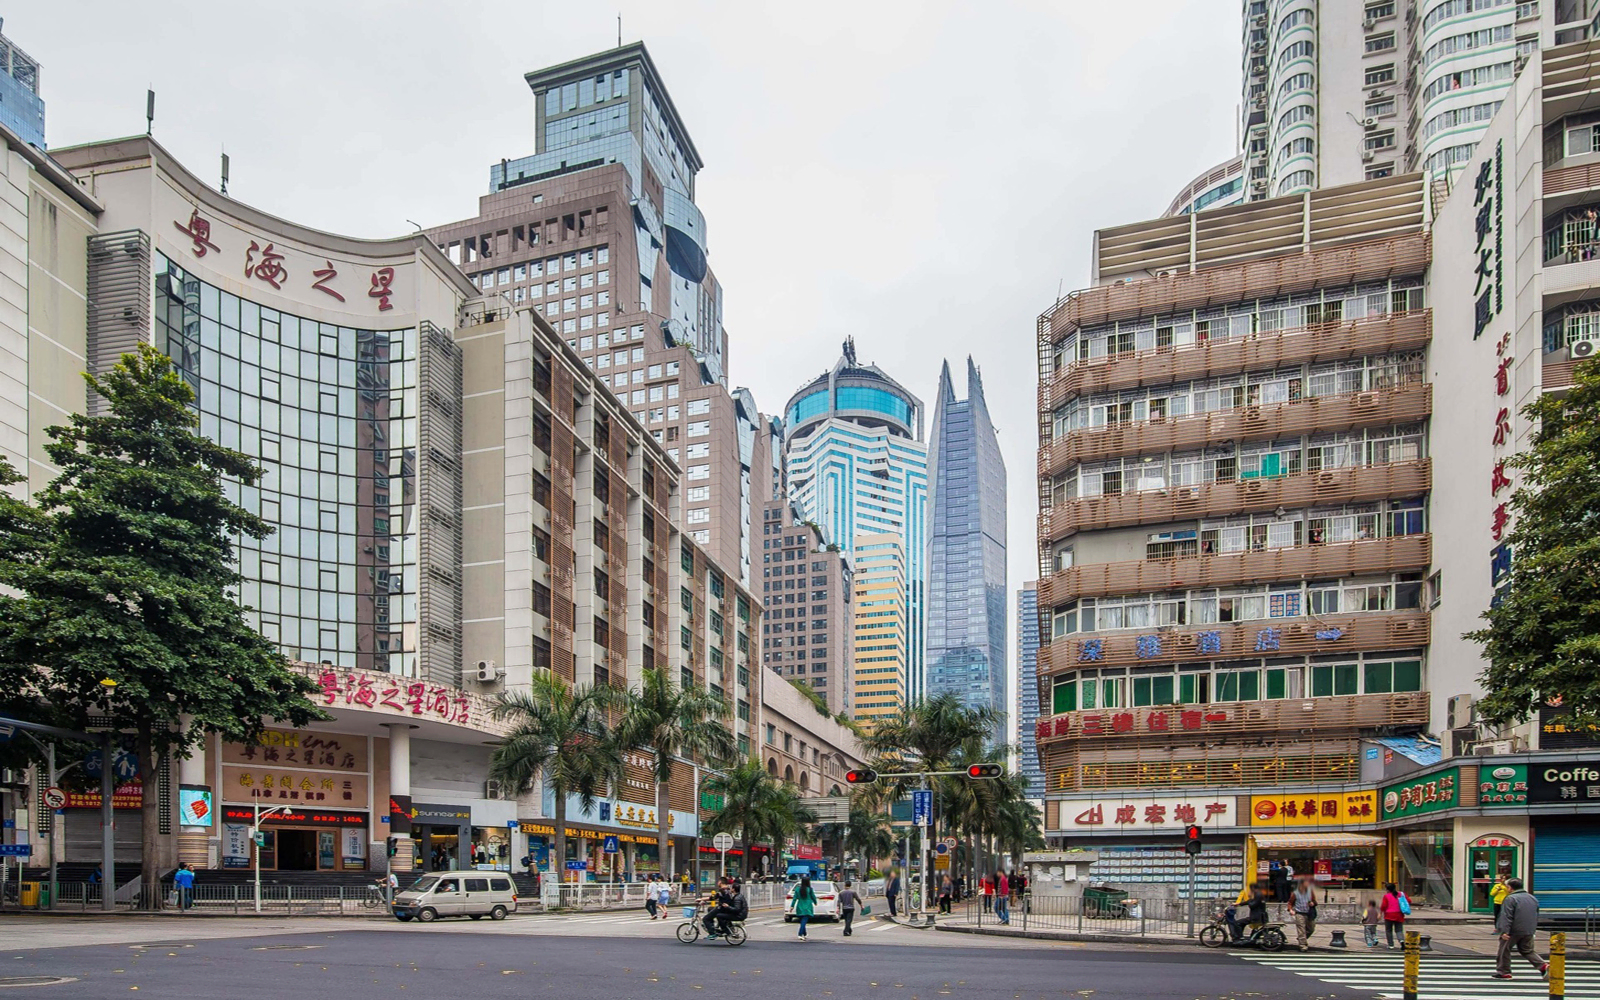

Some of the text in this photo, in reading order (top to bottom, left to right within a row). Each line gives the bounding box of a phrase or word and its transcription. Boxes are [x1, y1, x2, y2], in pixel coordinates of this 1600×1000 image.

[173, 208, 395, 312] 粤海之星
[1492, 356, 1514, 541] 首尔故事
[318, 668, 469, 724] 粤海之星酒店
[1114, 802, 1228, 824] 成宏地产
